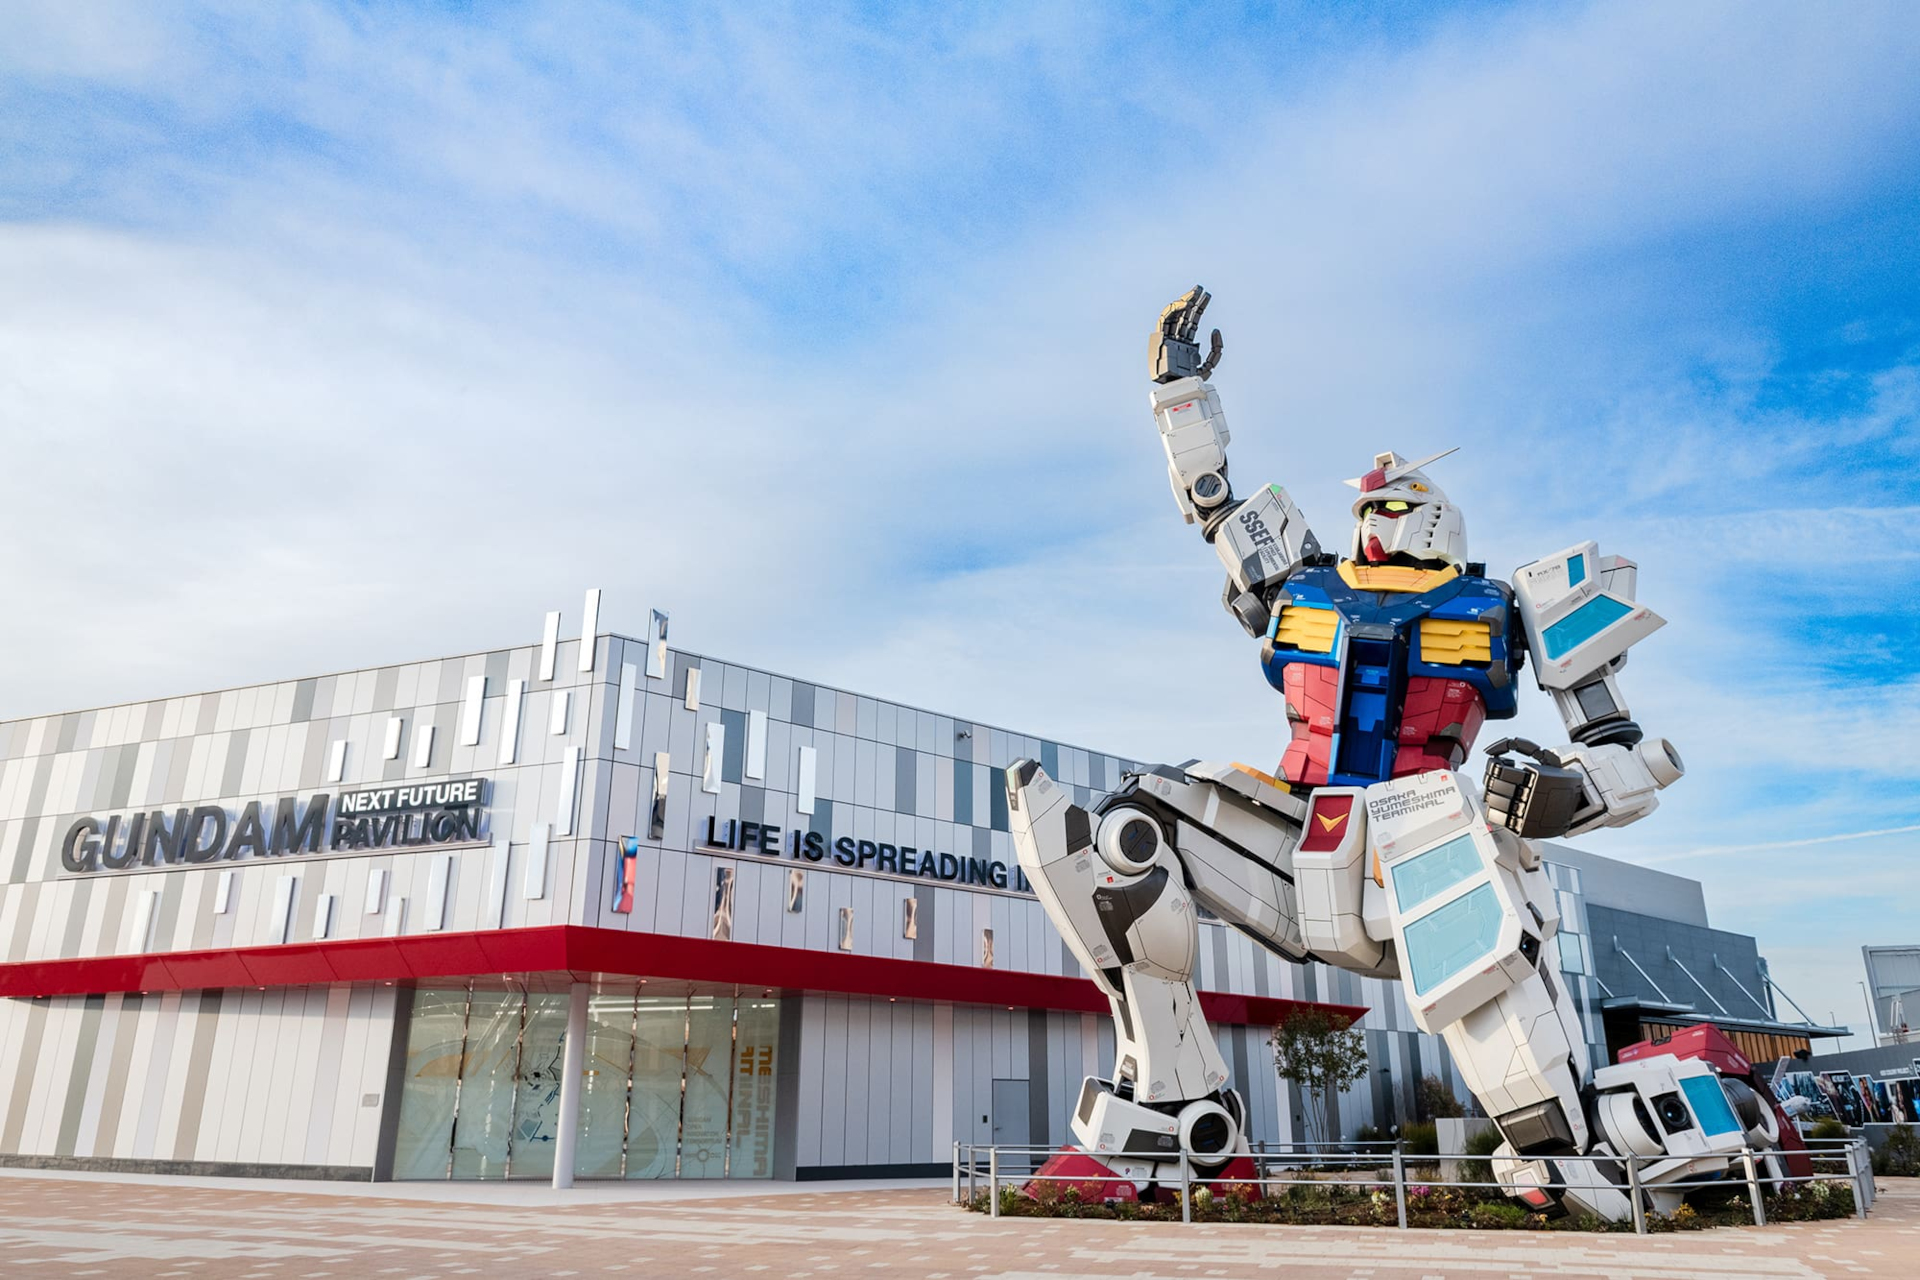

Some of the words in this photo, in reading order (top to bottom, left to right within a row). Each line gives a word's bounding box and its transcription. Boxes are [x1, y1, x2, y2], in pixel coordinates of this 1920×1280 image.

[1239, 510, 1275, 547] SSEF
[341, 789, 394, 814] NEXT
[396, 781, 478, 808] FUTURE
[1369, 789, 1416, 809] OSAKA
[1370, 786, 1456, 816] YUMESHIMA
[1372, 798, 1444, 823] TERMINAL
[61, 794, 330, 873] GUNDAM
[331, 807, 483, 850] PAVILION
[707, 815, 780, 856] LIFE
[793, 829, 824, 862] IS
[835, 836, 1007, 889] SPREADING
